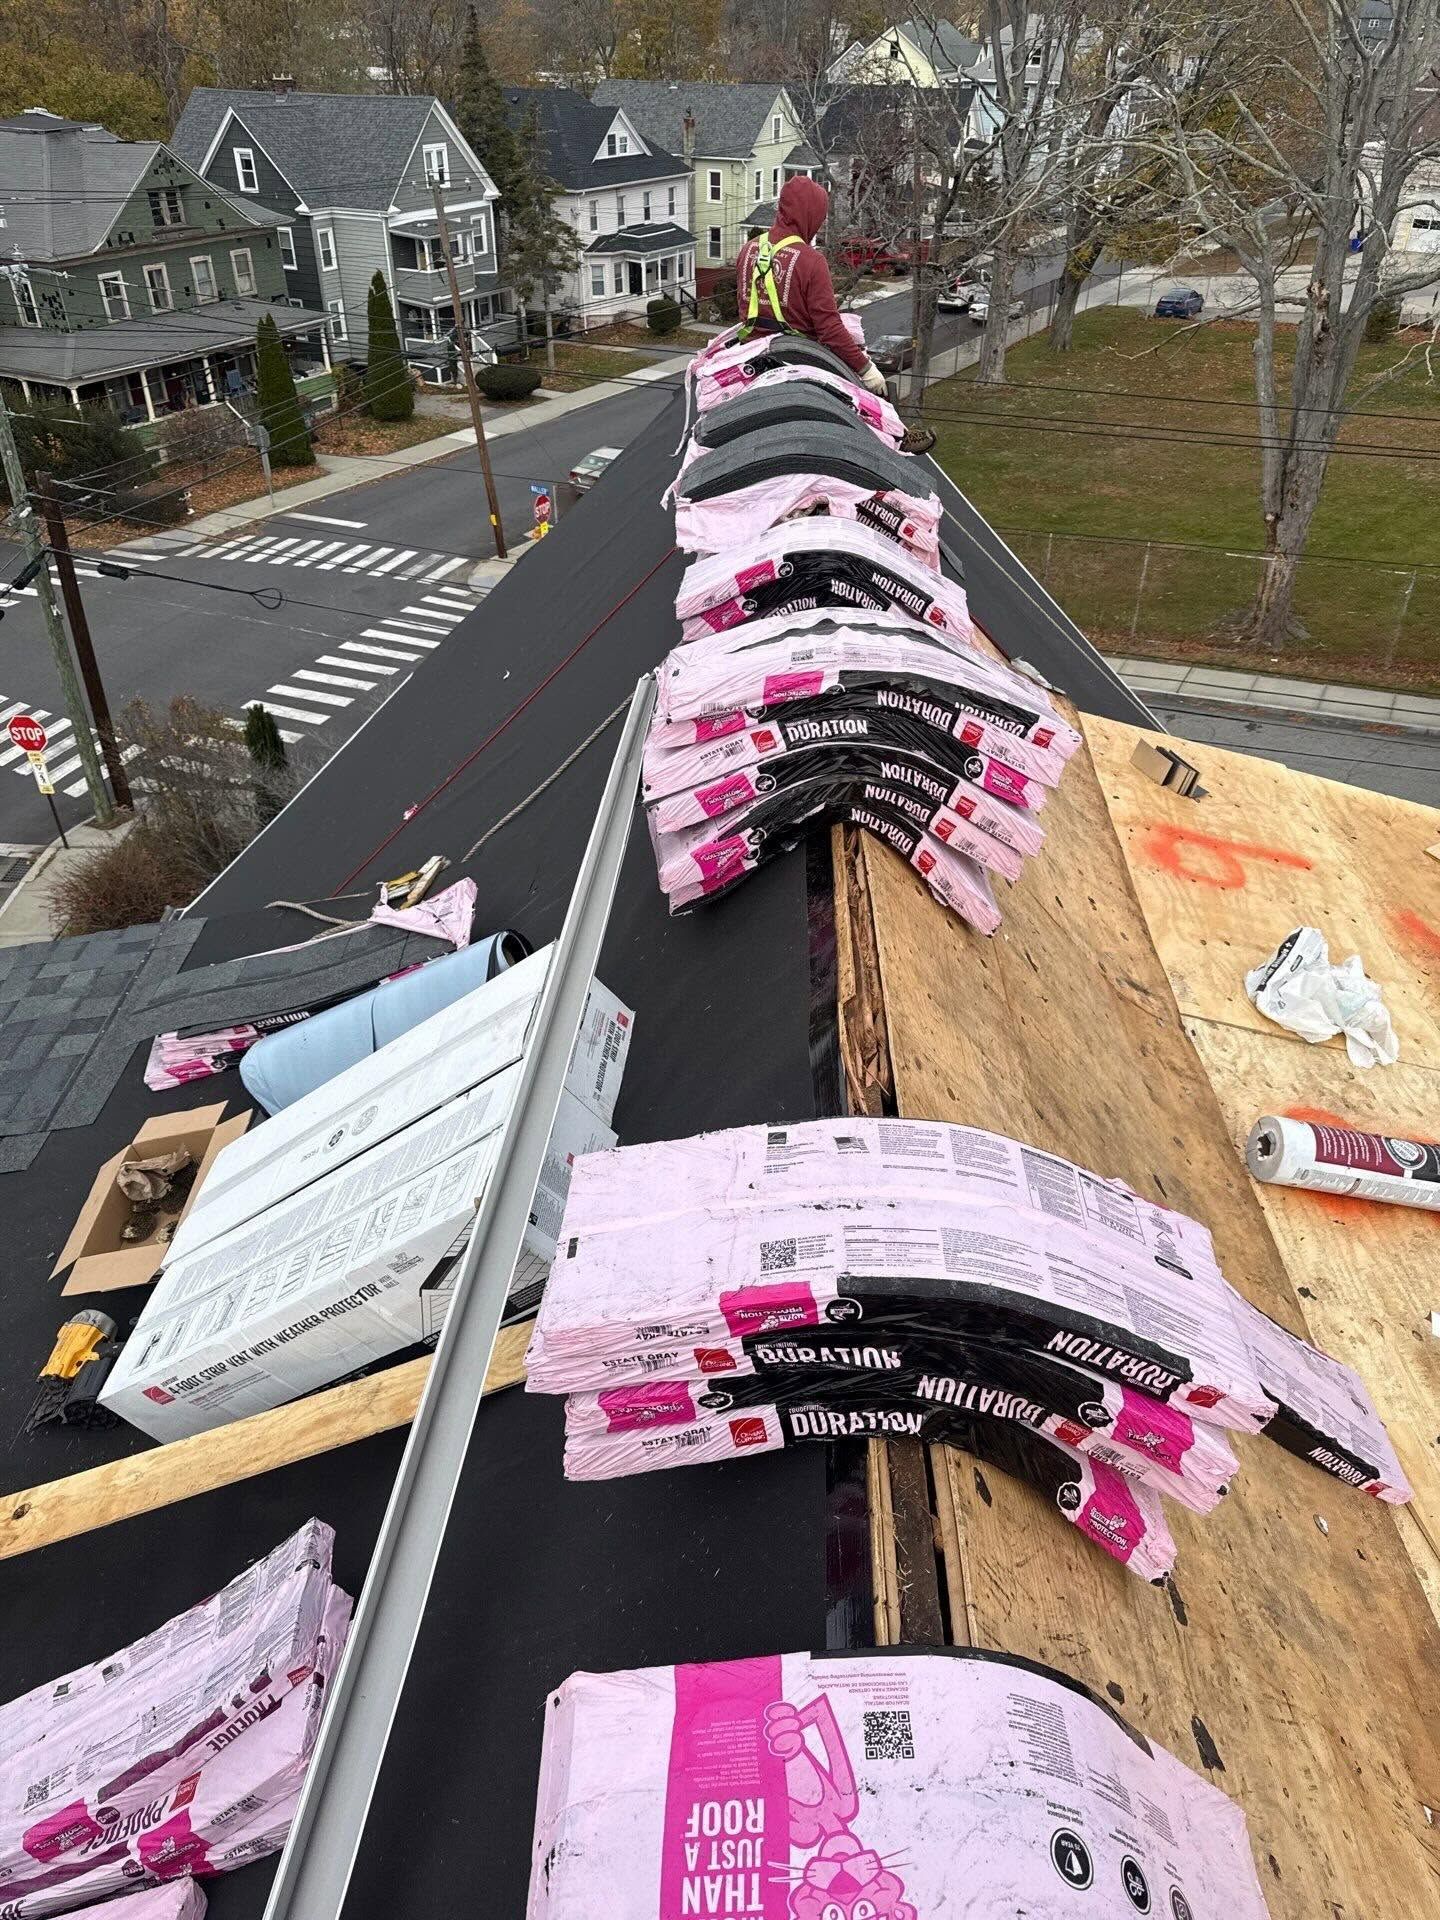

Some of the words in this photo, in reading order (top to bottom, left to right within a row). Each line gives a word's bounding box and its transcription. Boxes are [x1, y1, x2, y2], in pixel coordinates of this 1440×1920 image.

[535, 501, 550, 518] STOP
[872, 573, 926, 614] DURATION
[877, 690, 952, 730] DURATION
[11, 726, 43, 741] STOP
[786, 719, 868, 743] DURATION
[700, 745, 723, 760] ESTATE
[724, 739, 744, 751] GRAY
[880, 762, 949, 802] DURATION
[864, 784, 931, 823] DURATION
[851, 808, 914, 854] DURATION
[168, 1375, 204, 1395] 4-FOOT
[199, 1362, 229, 1381] STRIP
[225, 1350, 254, 1368] VENT
[249, 1338, 280, 1357] WITH
[274, 1314, 325, 1344] WEATHER
[319, 1283, 382, 1320] PROTECTOR
[602, 1354, 644, 1367] ESTATE
[647, 1351, 679, 1361] GRAY
[756, 1346, 902, 1369] DURATION
[1047, 1330, 1182, 1388] DURATION
[916, 1375, 1046, 1424] DURATION
[642, 1432, 679, 1447] ESTATE
[682, 1426, 712, 1438] GRAY
[790, 1411, 923, 1437] DURATION
[1308, 1446, 1368, 1485] DURATION
[211, 1804, 237, 1825] ESTATE
[236, 1794, 257, 1809] GRAY
[684, 1797, 765, 1837] ROOF
[684, 1841, 701, 1872] A
[707, 1837, 765, 1871] JUST
[682, 1873, 764, 1915] THAN
